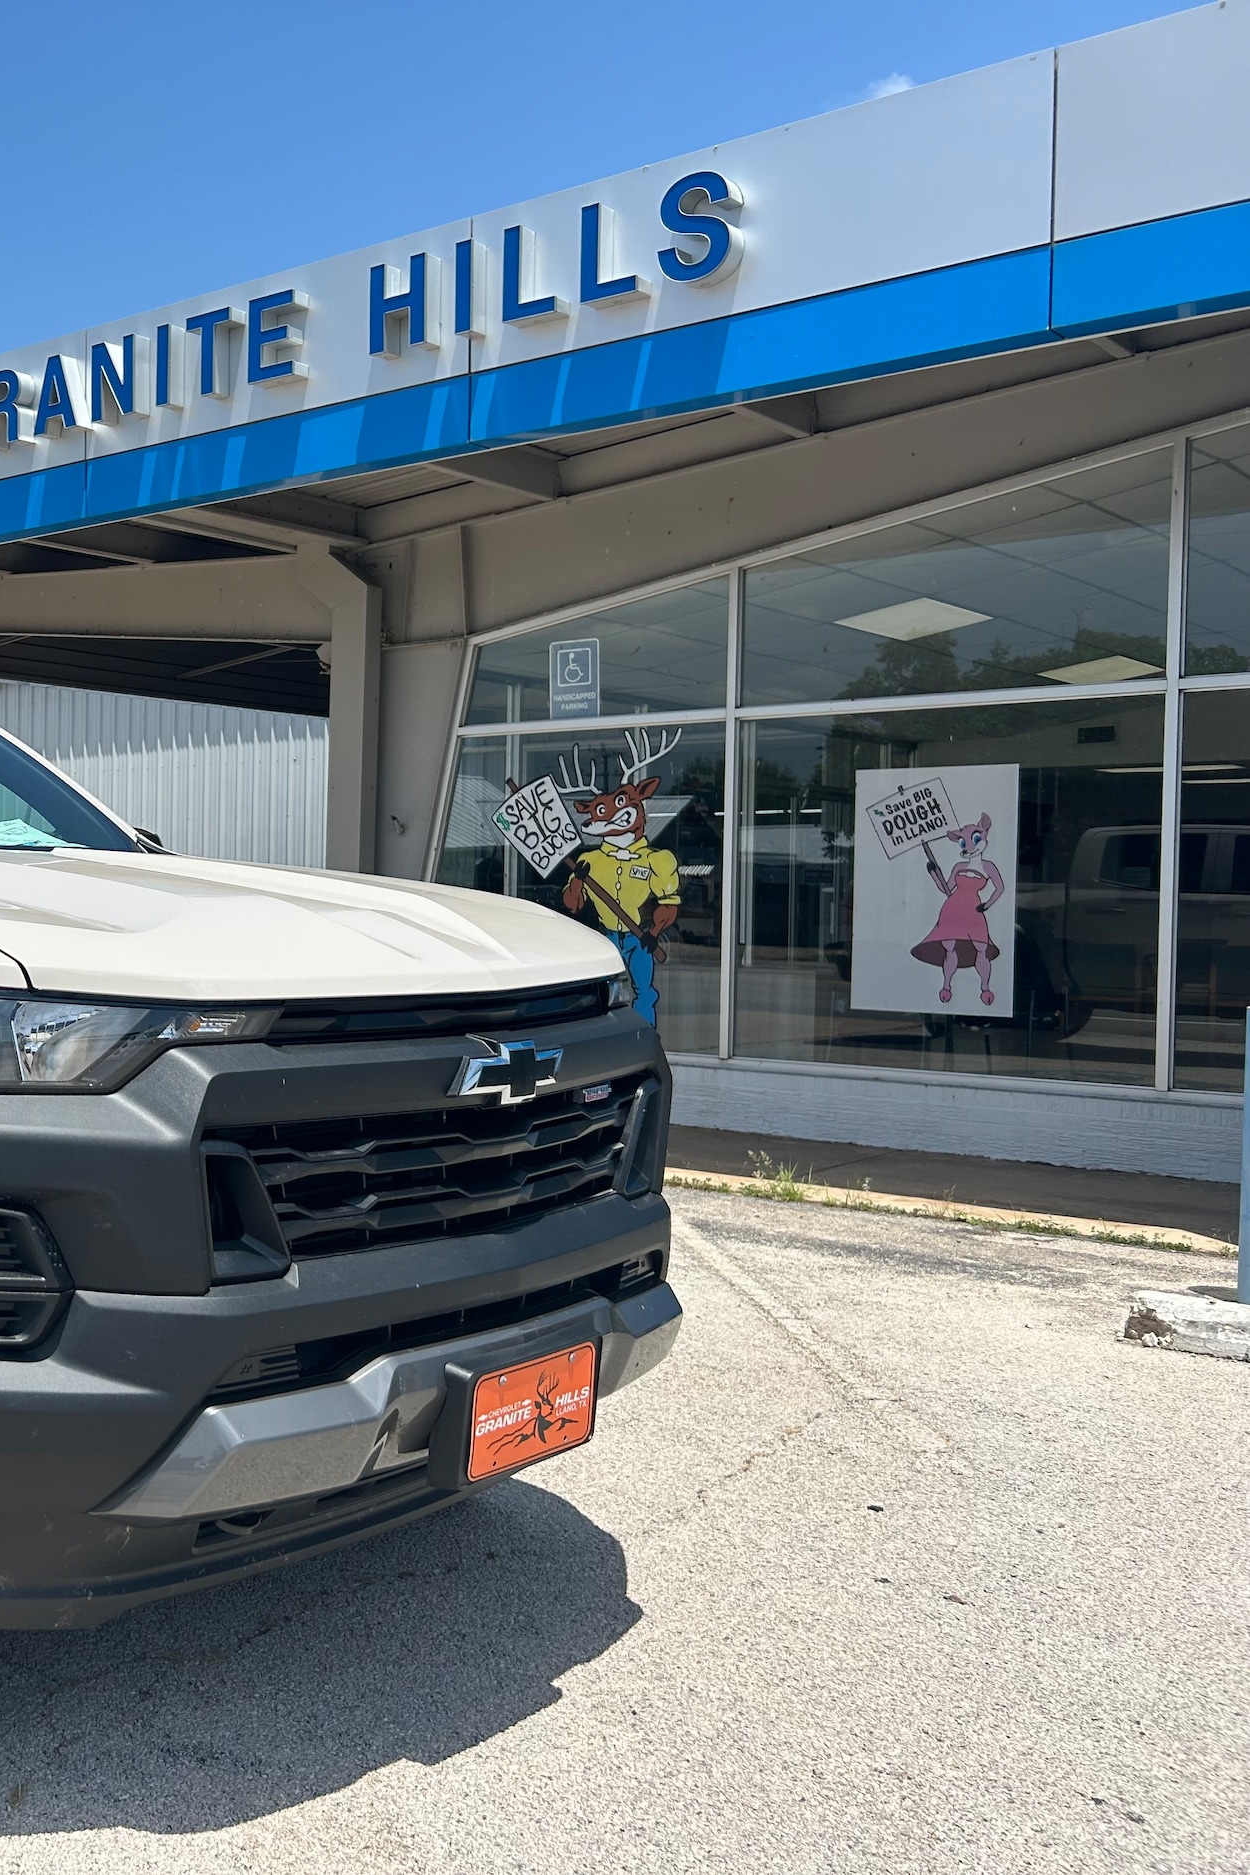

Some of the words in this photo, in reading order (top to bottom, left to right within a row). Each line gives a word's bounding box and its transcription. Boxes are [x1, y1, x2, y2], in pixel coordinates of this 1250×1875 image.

[369, 171, 745, 360] HILLS
[553, 691, 597, 702] HANDICAPPED
[561, 701, 589, 711] PARKING
[505, 780, 554, 825] SAVE
[882, 798, 942, 836] DOUGH
[885, 798, 912, 815] Save
[913, 788, 932, 803] BIG
[513, 805, 561, 850] BIG
[891, 834, 904, 846] in
[904, 814, 948, 841] LLANO!
[531, 822, 577, 870] BUCKS
[475, 1405, 532, 1437] GRANITE
[555, 1386, 589, 1408] HILLS
[488, 1400, 521, 1418] CHEVROLET
[578, 1399, 587, 1409] TX
